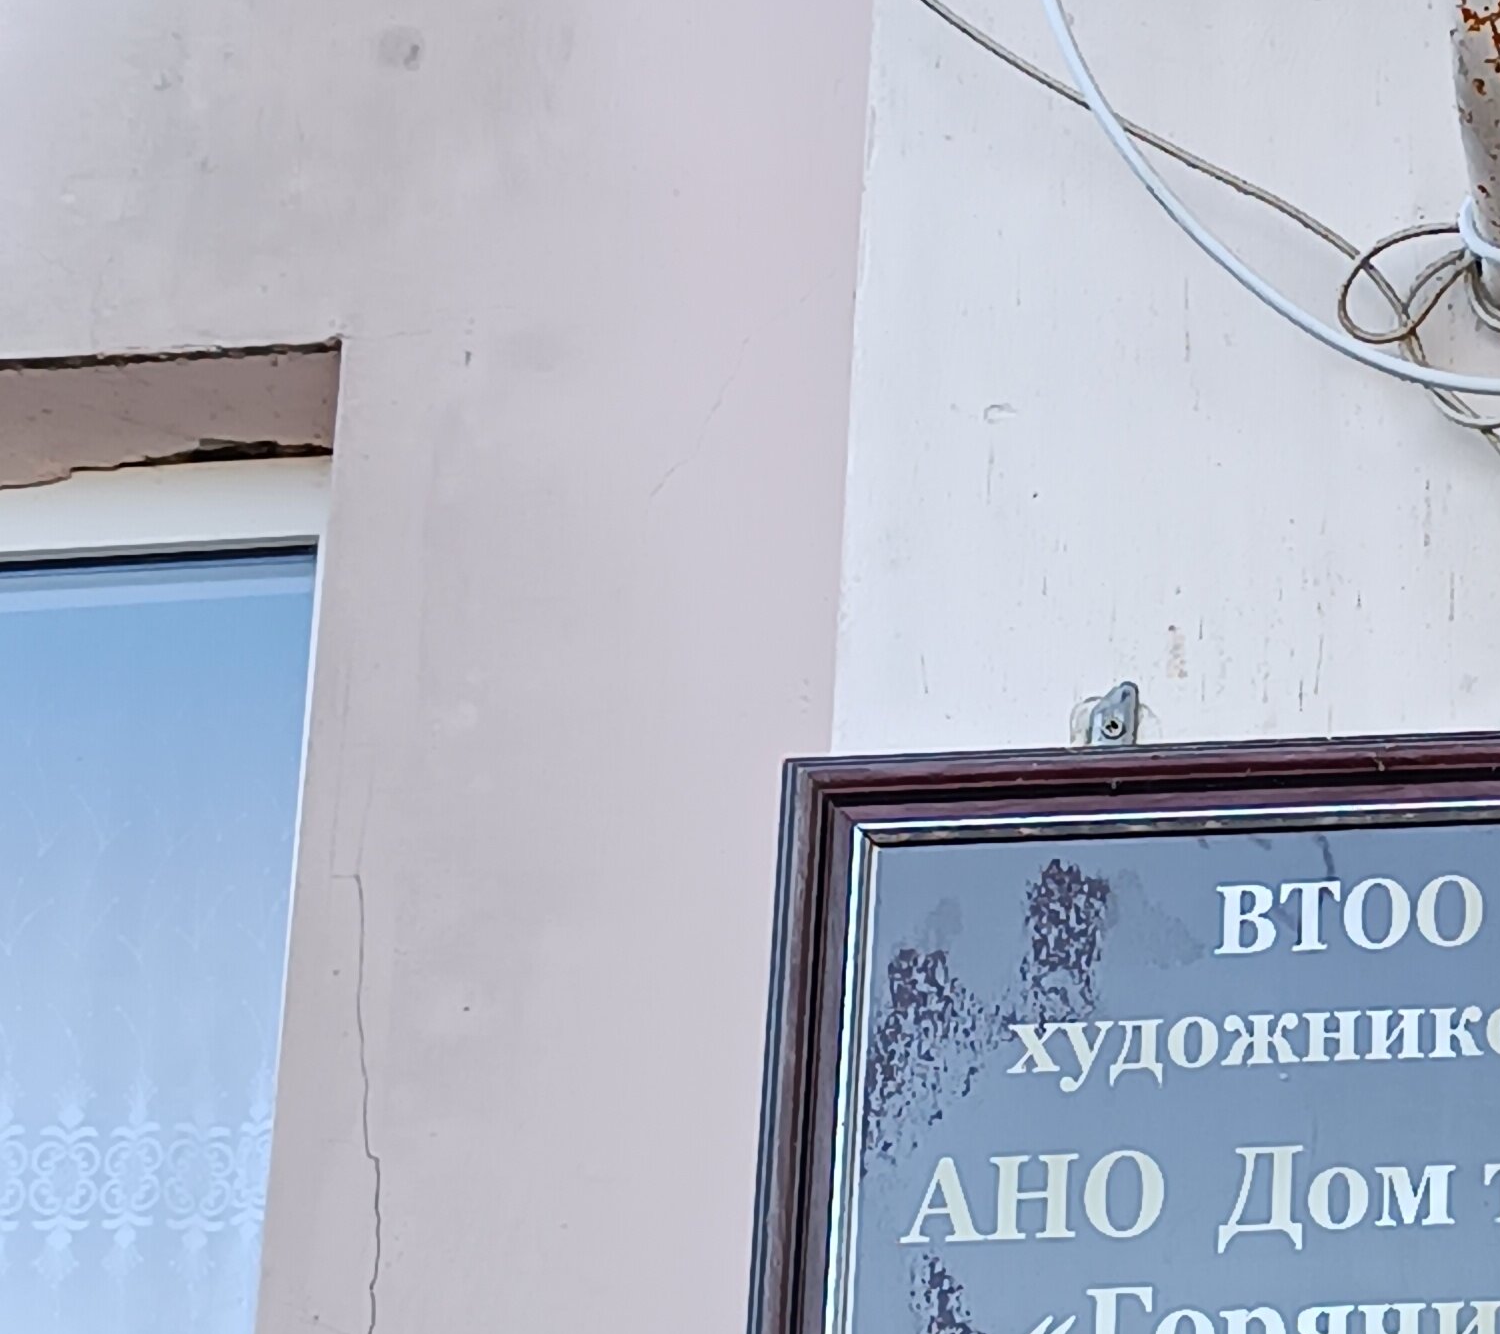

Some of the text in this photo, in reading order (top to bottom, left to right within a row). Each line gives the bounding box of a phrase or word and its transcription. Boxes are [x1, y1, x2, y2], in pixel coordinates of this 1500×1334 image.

[1214, 874, 1484, 956] ВТОО
[899, 1150, 1166, 1245] АНО
[1217, 1145, 1458, 1254] Дом
